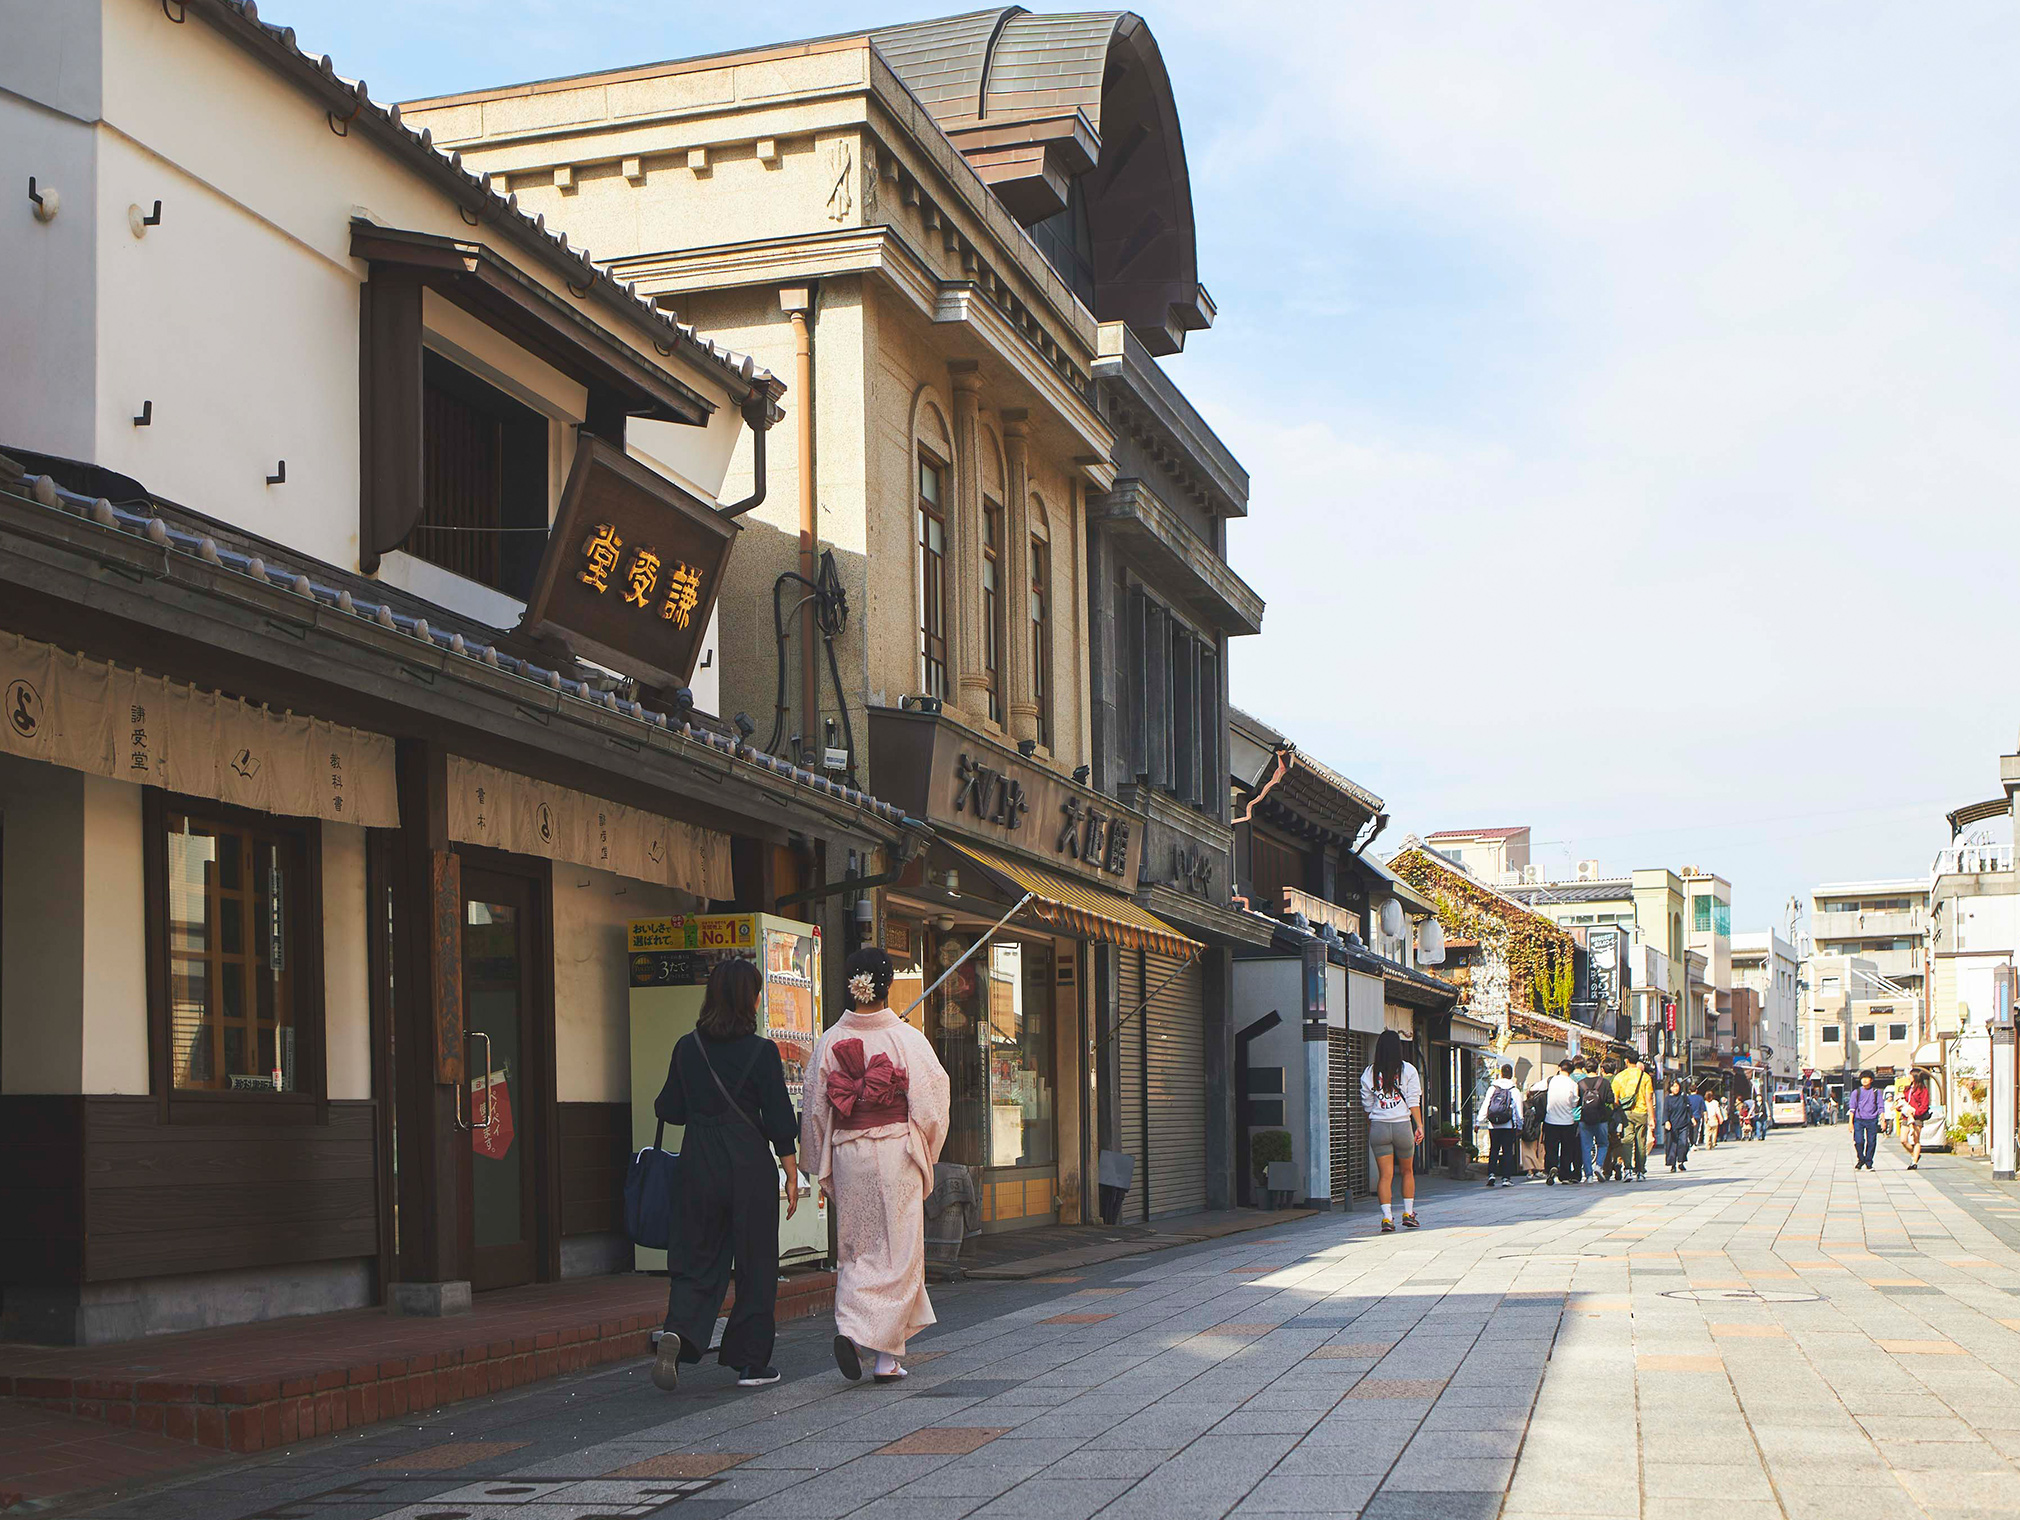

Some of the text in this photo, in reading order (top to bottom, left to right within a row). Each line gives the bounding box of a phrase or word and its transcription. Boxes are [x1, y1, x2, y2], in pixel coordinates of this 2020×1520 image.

[633, 923, 671, 934] おいしさで
[702, 920, 736, 945] No.1
